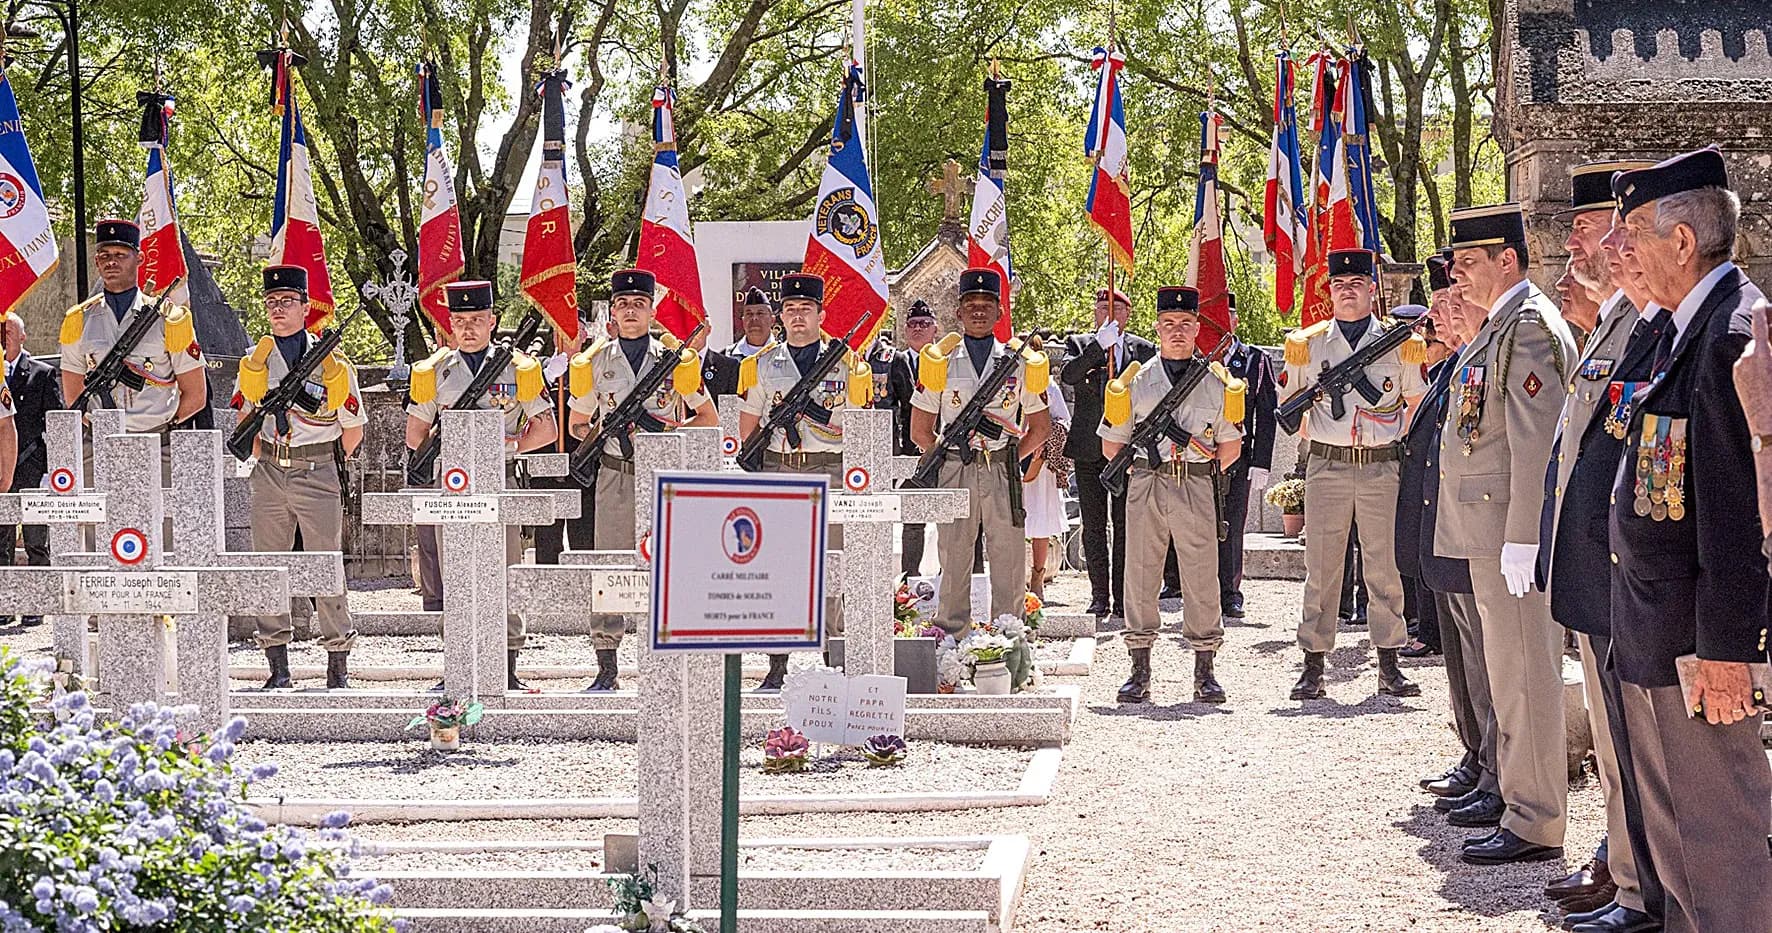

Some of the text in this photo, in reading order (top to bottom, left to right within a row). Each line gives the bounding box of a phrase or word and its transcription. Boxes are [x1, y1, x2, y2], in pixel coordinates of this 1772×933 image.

[817, 189, 853, 234] VETERANS
[855, 225, 878, 256] FRANCE
[80, 576, 181, 589] FERRIER Joseph Denis
[89, 591, 107, 599] MORT
[145, 591, 173, 599] FRANCE
[704, 612, 727, 620] MORTS
[748, 612, 775, 620] FRANCE
[868, 686, 879, 694] ET
[808, 694, 838, 704] NOTRE
[802, 718, 834, 729] ÉPOUX
